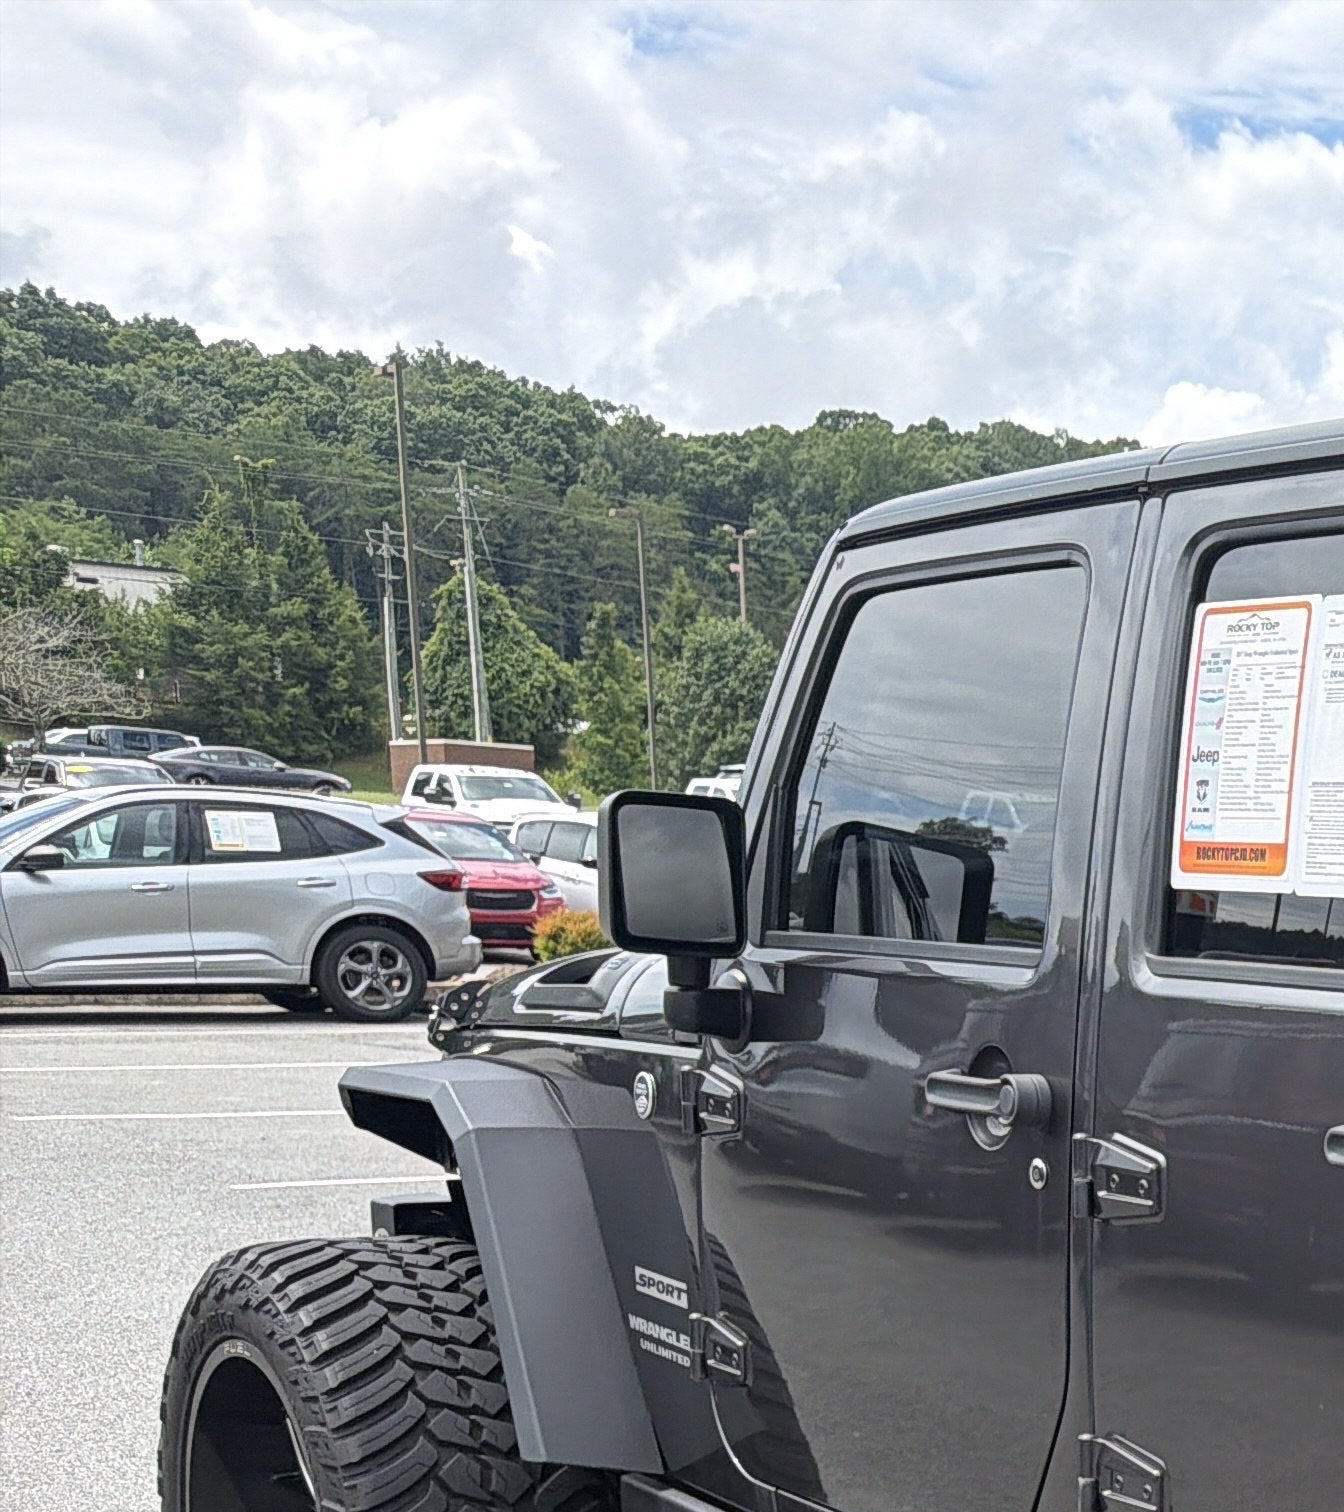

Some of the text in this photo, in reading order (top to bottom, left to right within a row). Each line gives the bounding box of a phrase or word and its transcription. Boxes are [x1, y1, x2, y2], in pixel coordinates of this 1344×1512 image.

[1226, 621, 1280, 633] ROCKY TOP
[1192, 745, 1220, 767] Jeep
[638, 1272, 688, 1302] SPORT
[628, 1312, 691, 1352] WRANGLE
[640, 1338, 691, 1368] UNLIMITED
